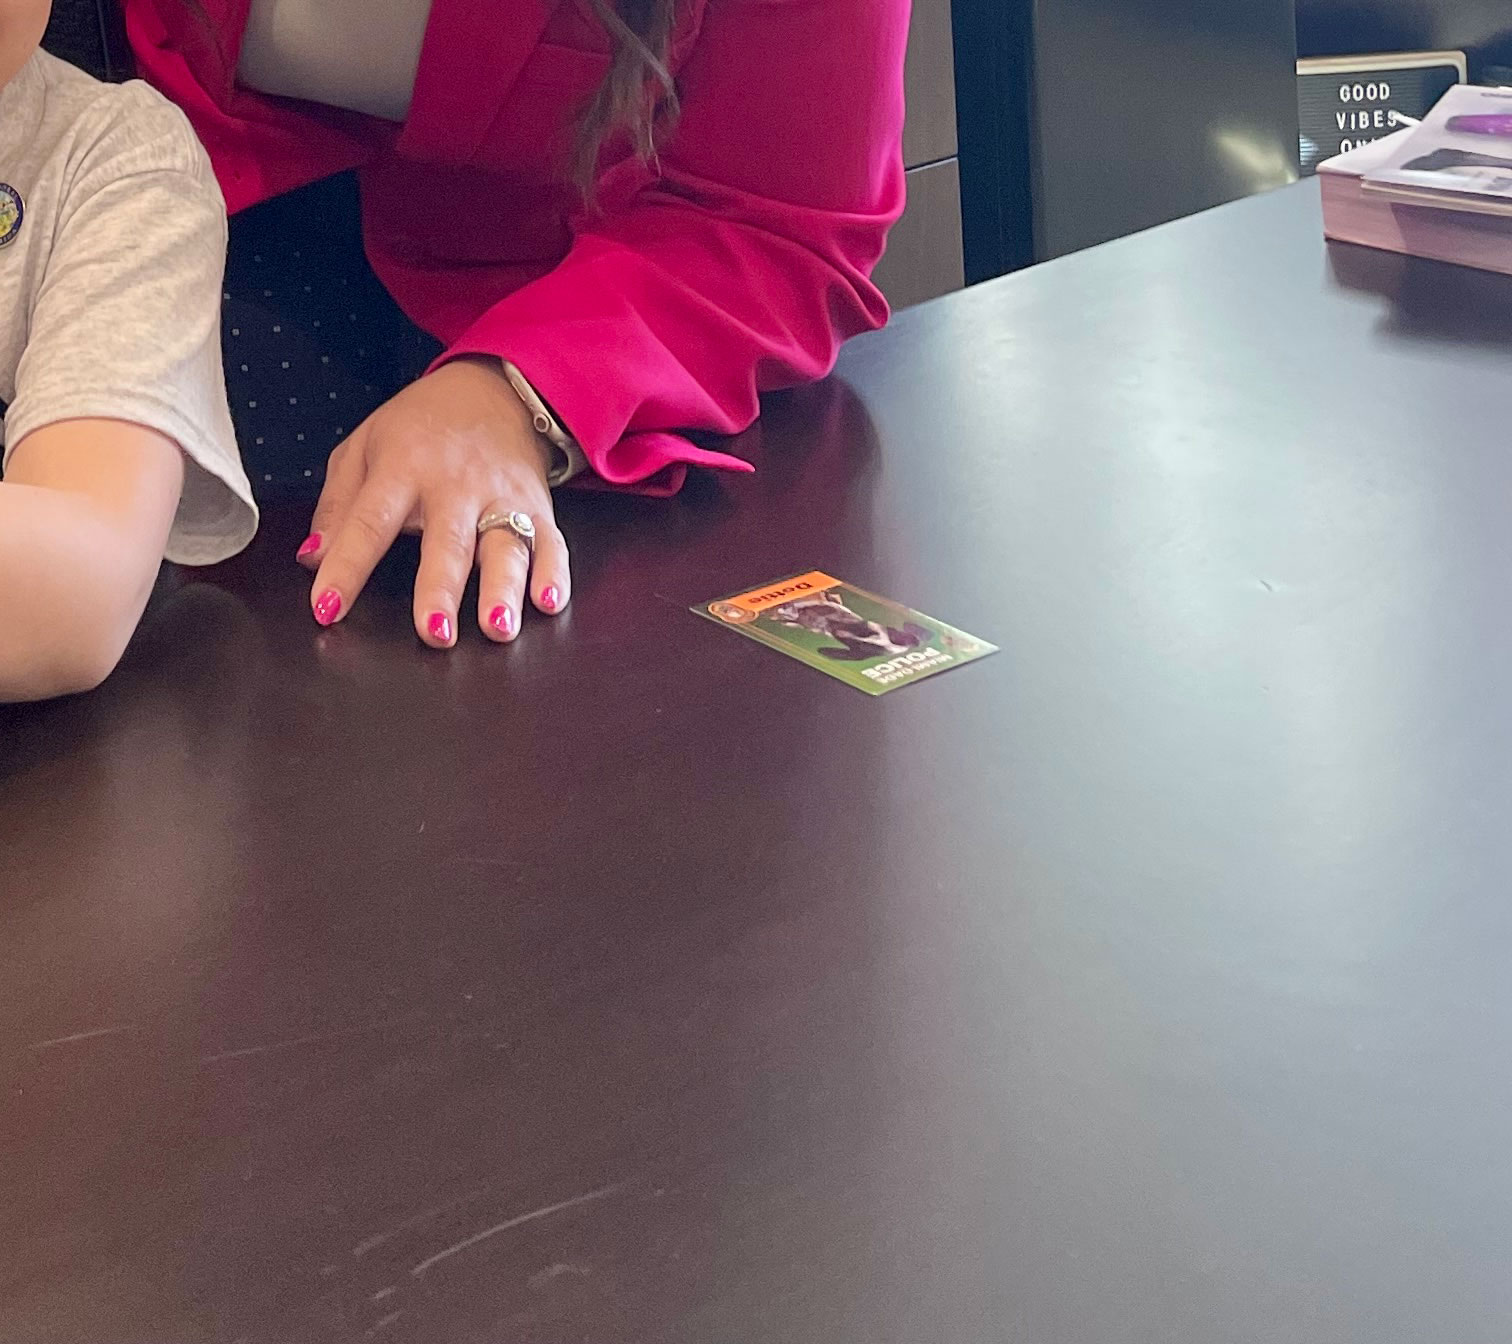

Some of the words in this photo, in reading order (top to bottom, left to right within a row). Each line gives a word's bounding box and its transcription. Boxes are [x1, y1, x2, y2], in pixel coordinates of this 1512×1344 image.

[1339, 82, 1391, 103] GOOD
[1336, 109, 1398, 131] VIBES
[861, 646, 941, 680] POLICE
